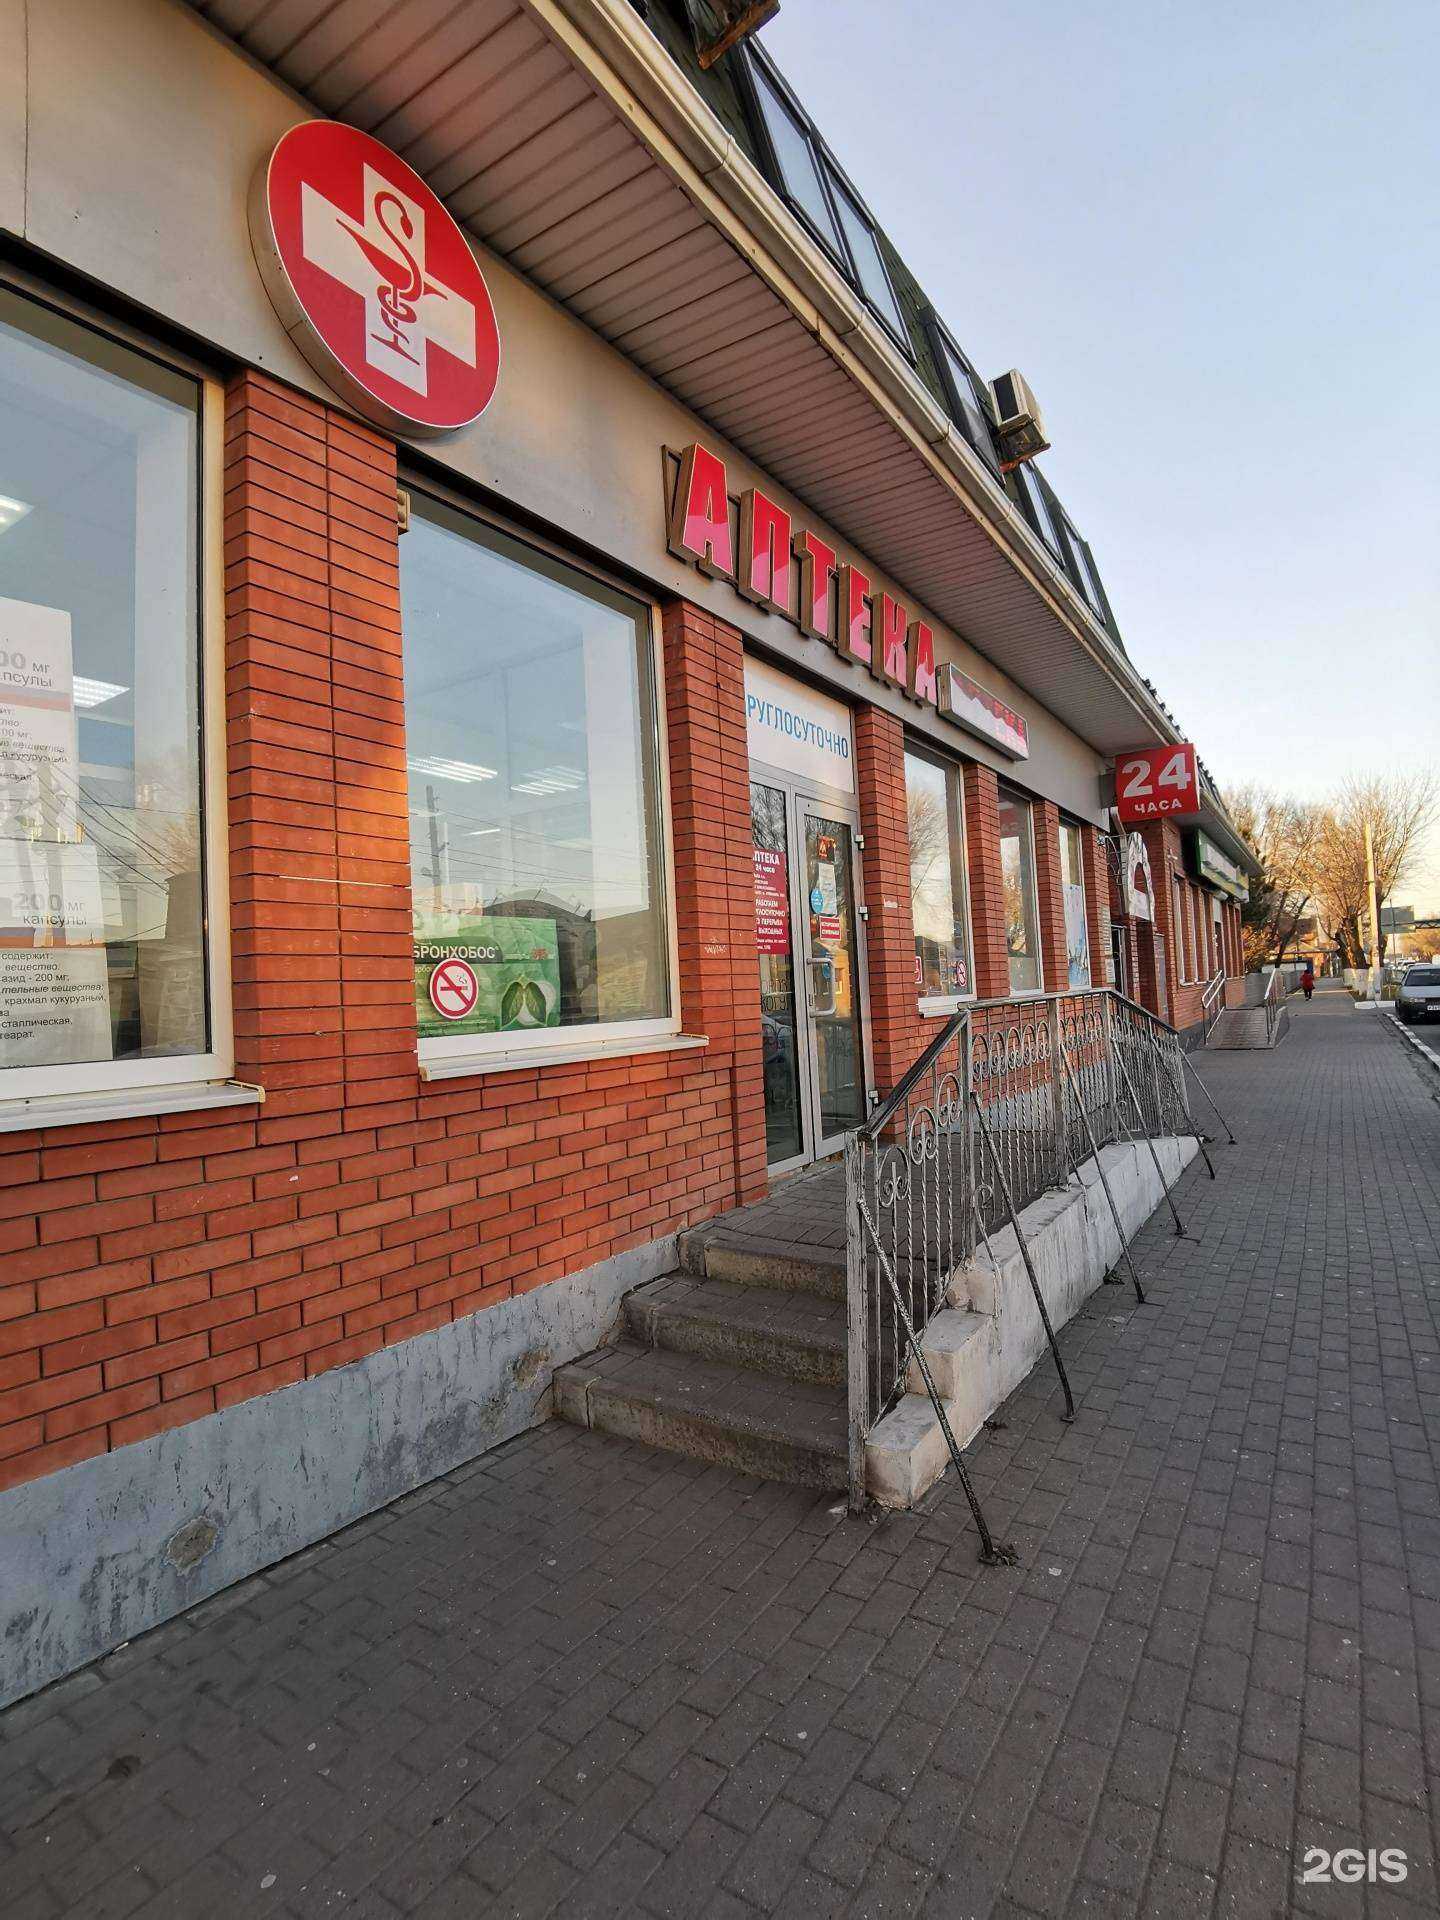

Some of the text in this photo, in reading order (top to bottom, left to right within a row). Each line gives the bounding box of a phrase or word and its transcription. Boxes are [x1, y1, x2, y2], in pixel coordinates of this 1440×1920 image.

[682, 442, 937, 707] АПТЕКА
[0, 671, 52, 687] псулы
[747, 694, 849, 759] РУГЛОСУТОЧНО
[1122, 753, 1191, 798] 24
[1134, 798, 1183, 814] ЧАСА
[23, 913, 87, 927] капсулы
[35, 973, 53, 982] 200
